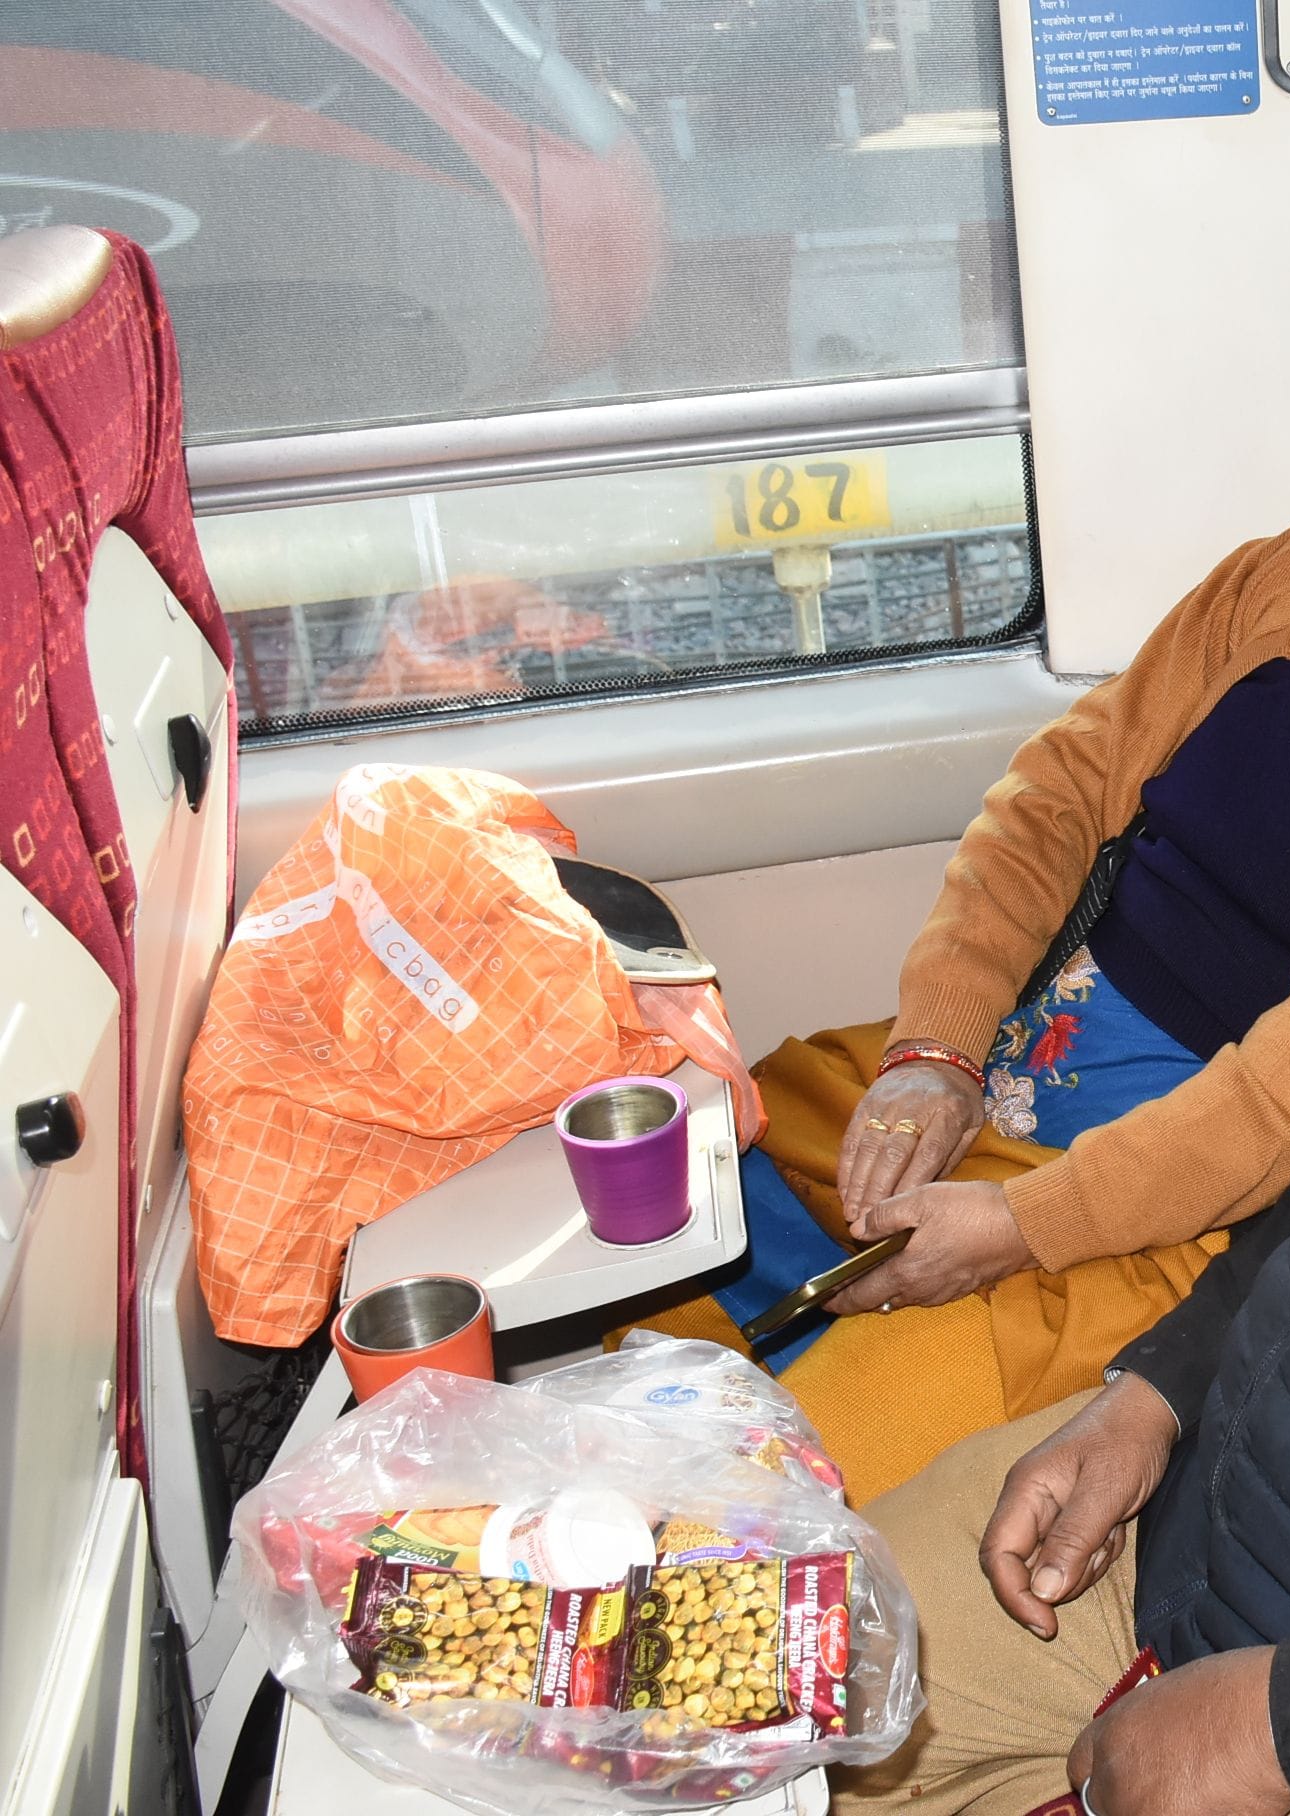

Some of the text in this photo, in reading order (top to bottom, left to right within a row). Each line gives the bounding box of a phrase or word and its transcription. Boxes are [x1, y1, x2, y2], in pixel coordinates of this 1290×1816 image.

[1077, 16, 1087, 24] पर
[1089, 15, 1102, 24] बात
[1042, 32, 1053, 43] ट्रेन
[1130, 27, 1143, 38] दिए
[1145, 27, 1159, 37] जाने
[1161, 26, 1174, 36] वाले
[1203, 25, 1212, 33] का
[1215, 24, 1231, 32] पालन
[1058, 53, 1073, 61] बटन
[1075, 50, 1085, 60] को
[1141, 46, 1151, 58] ट्रेन
[1226, 42, 1241, 51] कॉल
[1081, 64, 1091, 72] कर
[1093, 61, 1108, 71] दिया
[1111, 62, 1132, 71] जाएगा
[1046, 80, 1064, 91] केवल
[1111, 77, 1119, 86] ही
[1209, 72, 1227, 80] कारण
[1229, 70, 1237, 80] के
[1239, 69, 1253, 80] बिना
[1094, 89, 1109, 99] किए
[1111, 88, 1125, 97] जाने
[1126, 88, 1136, 96] पर
[1179, 83, 1195, 94] किया
[726, 463, 850, 540] 187
[565, 1594, 583, 1646] ROASTED
[599, 1599, 612, 1638] NEW PACK
[543, 1630, 564, 1696] HEENG JEERA
[557, 1647, 573, 1688] CHANA
